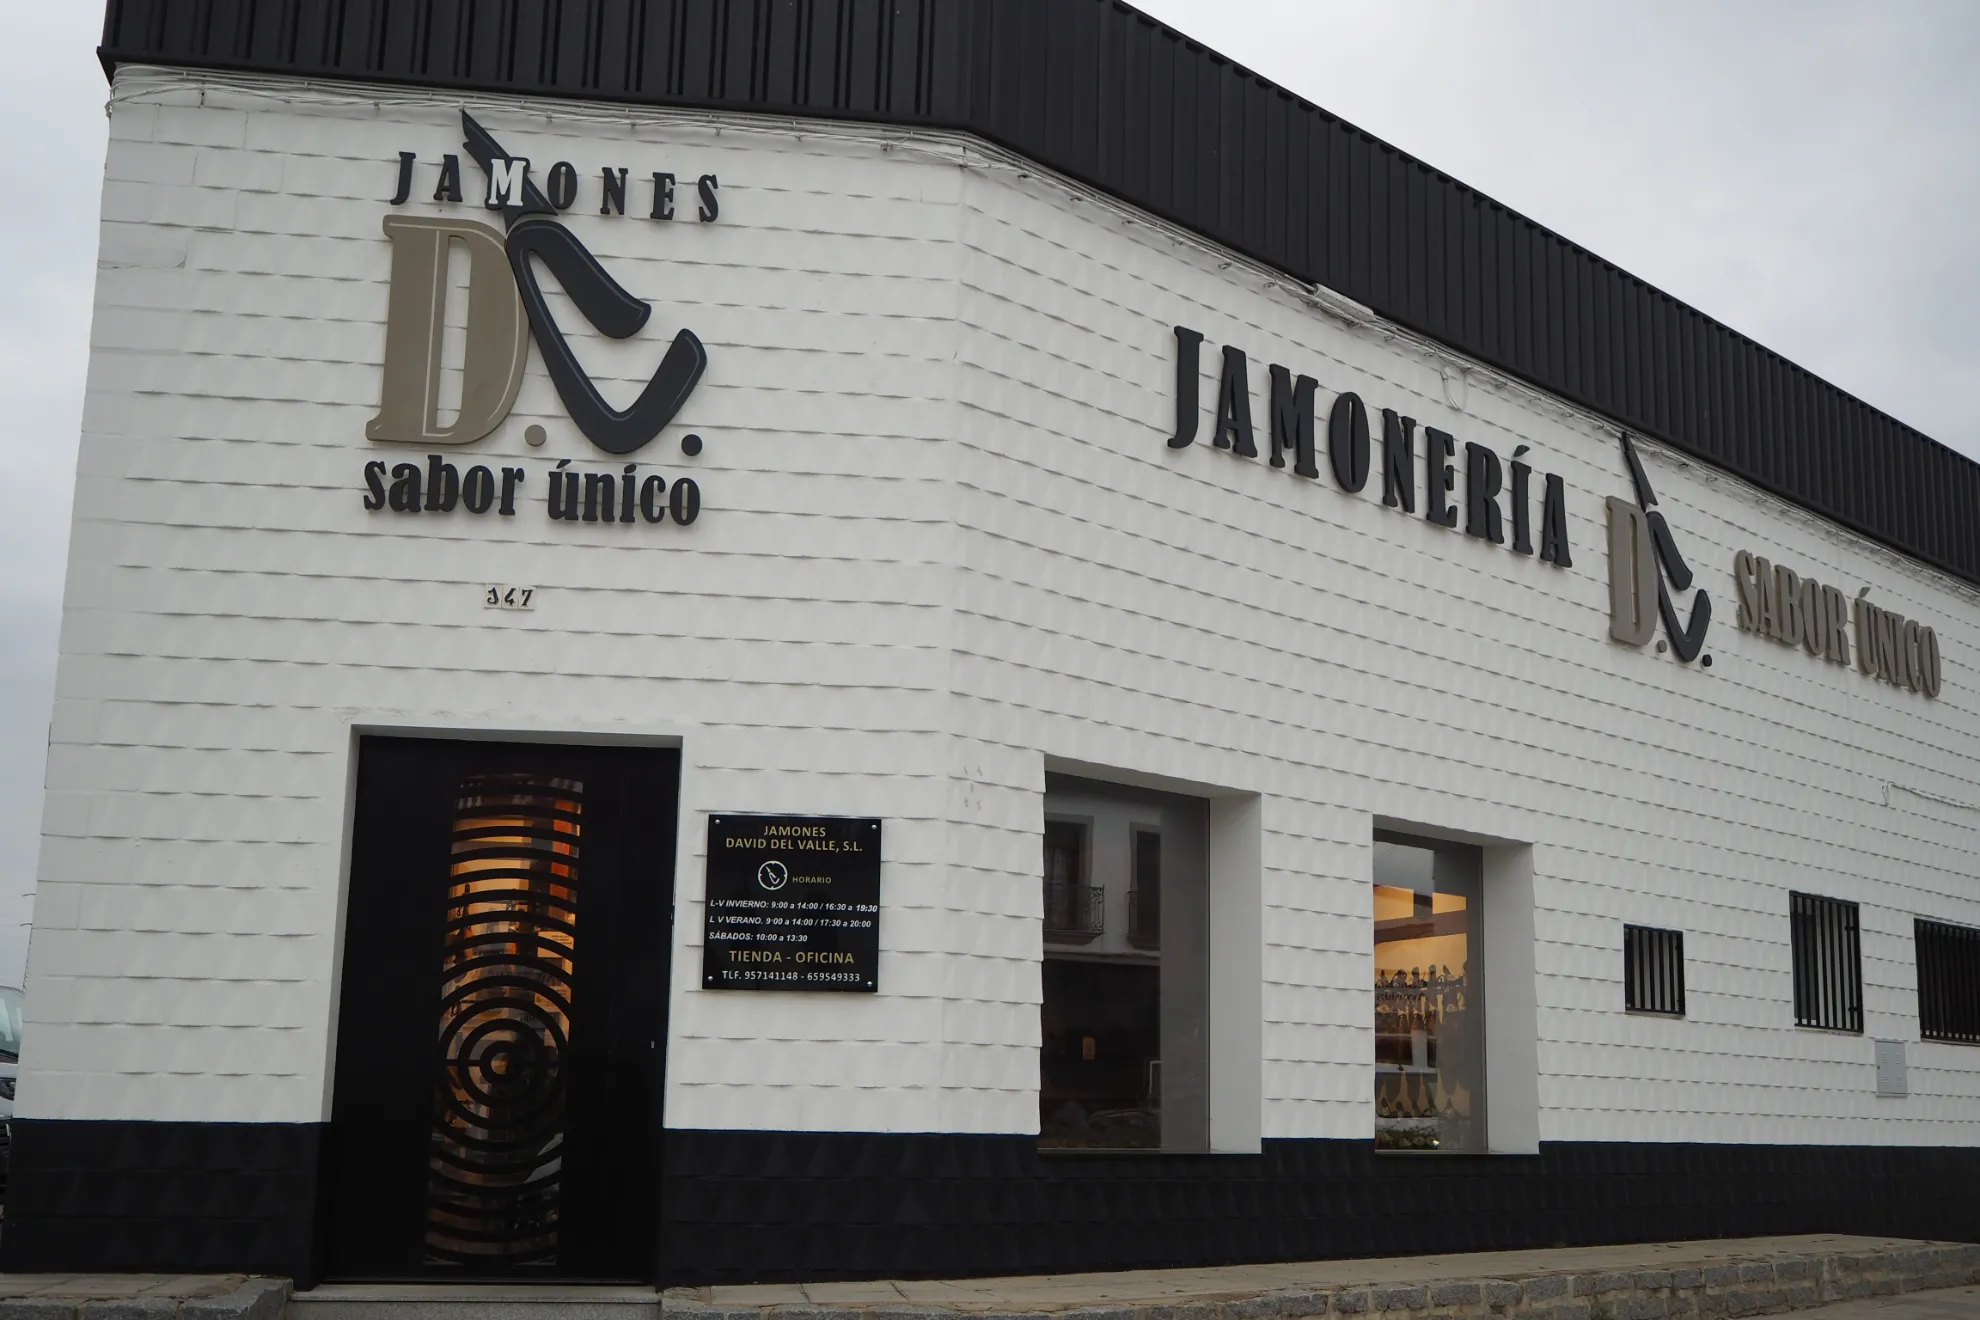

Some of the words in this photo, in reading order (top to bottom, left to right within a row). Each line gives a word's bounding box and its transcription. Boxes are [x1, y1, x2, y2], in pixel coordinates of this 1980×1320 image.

[390, 151, 719, 223] JAMONES
[1167, 325, 1573, 568] JAMONERÍA
[363, 455, 525, 515] sabor
[548, 459, 701, 527] único
[1735, 549, 1850, 667] SABOR
[1854, 586, 1941, 698] ÚNICO
[764, 825, 826, 837] JAMONES
[725, 837, 767, 849] DAVID
[770, 839, 794, 850] DEL
[797, 840, 839, 852] VALLE,
[843, 841, 863, 851] S.L.
[792, 876, 832, 884] HORARIO
[710, 899, 724, 908] L-V
[725, 900, 770, 909] INVIERNO:
[771, 901, 788, 909] 9:00
[797, 902, 819, 910] 14:00
[825, 903, 846, 911] 16:30
[855, 904, 878, 913] 19:30
[792, 918, 814, 926] 14:00
[820, 919, 841, 927] 17:30
[850, 920, 871, 928] 20:00
[709, 930, 753, 941] SÁBADOS:
[756, 933, 778, 941] 10:00
[786, 934, 808, 942] 13:30
[729, 950, 782, 963] TIENDA
[795, 951, 855, 964] OFICINA
[722, 970, 741, 980] TLF.
[744, 971, 798, 981] 957141148
[807, 972, 860, 982] 659549333
